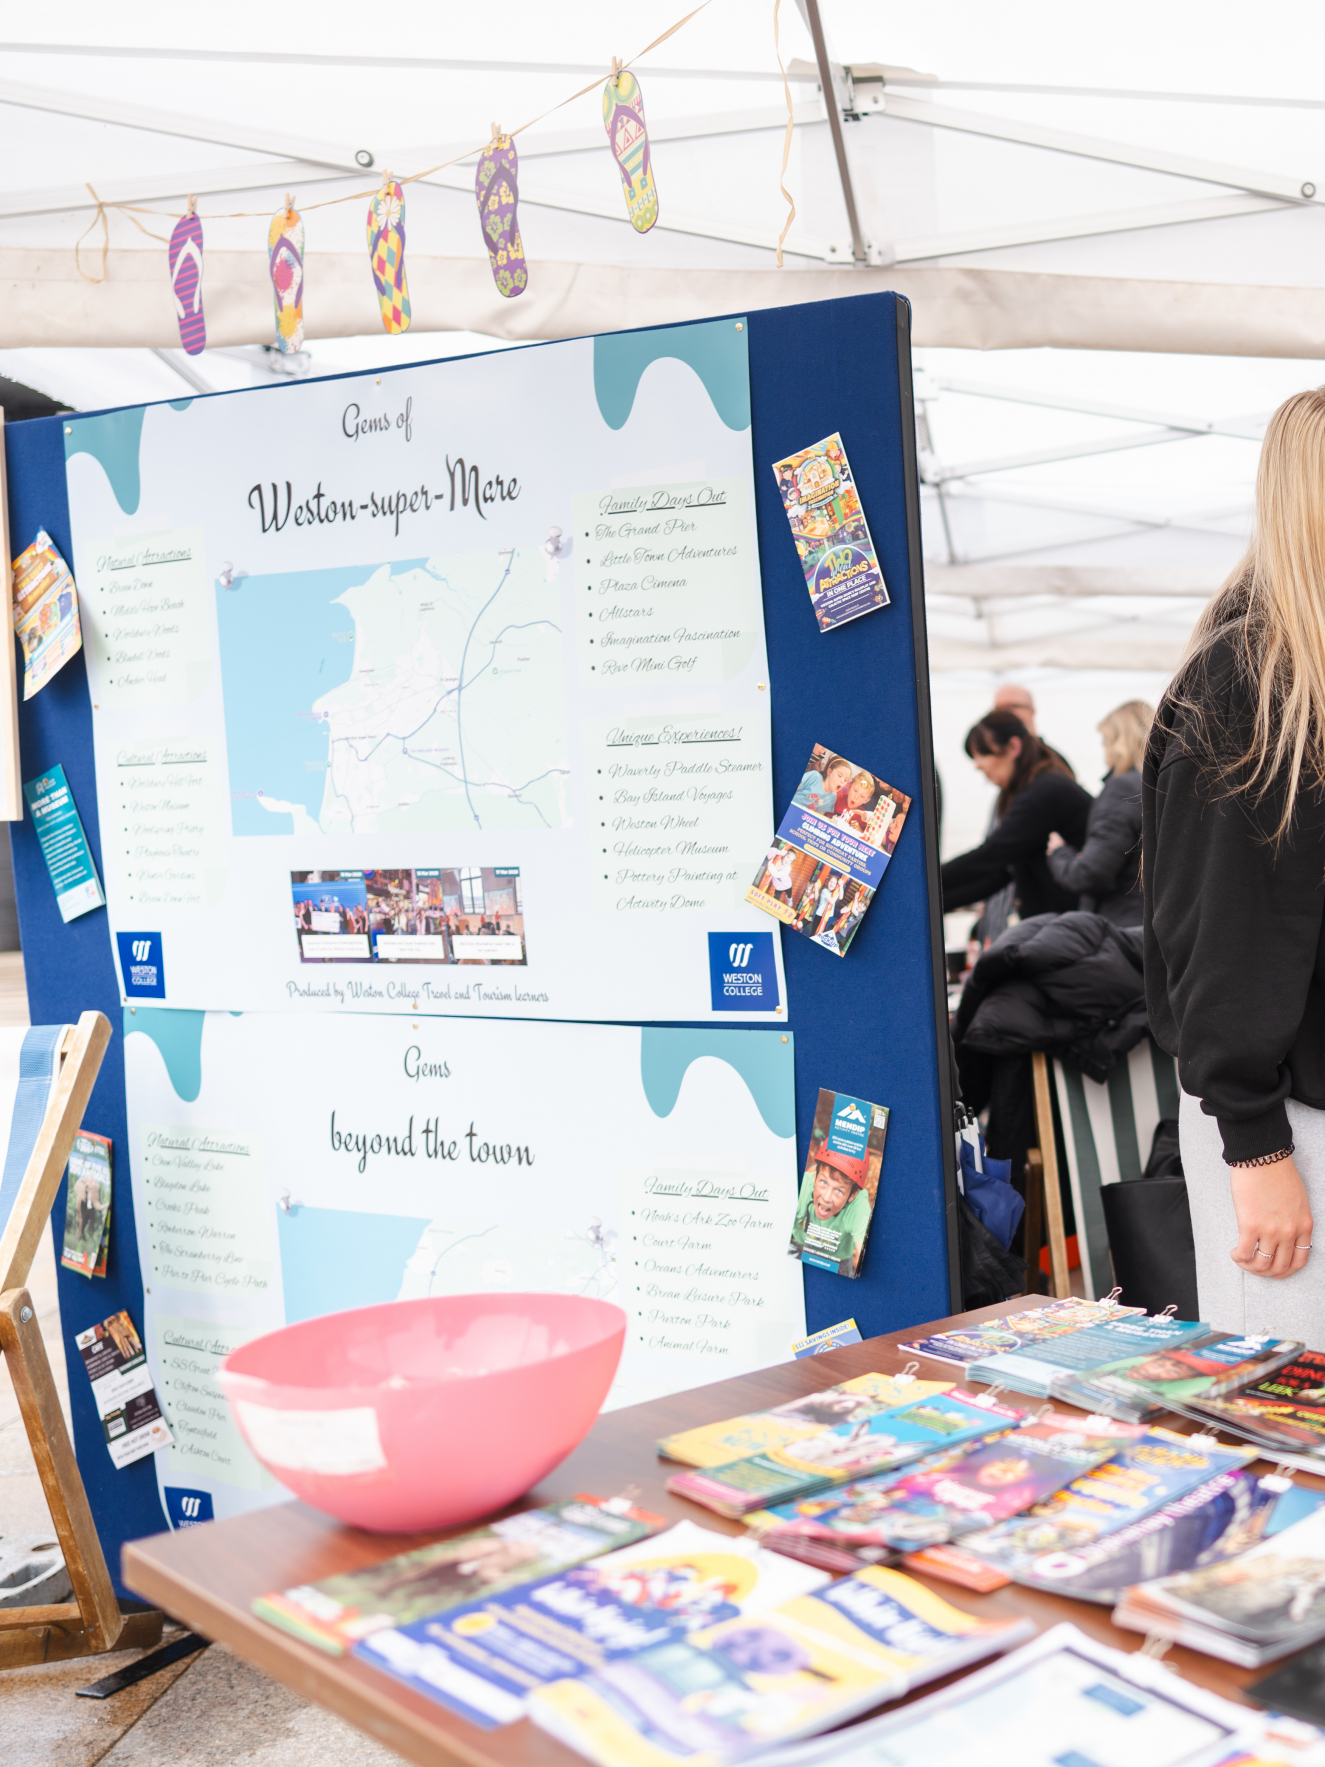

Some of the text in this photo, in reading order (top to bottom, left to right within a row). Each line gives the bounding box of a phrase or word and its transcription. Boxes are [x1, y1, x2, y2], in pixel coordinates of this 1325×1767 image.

[342, 396, 413, 442] Gems of
[248, 453, 522, 537] Weston-super-Mare
[599, 486, 728, 516] Family Days Out
[595, 518, 698, 541] The Grand Pier
[599, 545, 739, 568] Little Town Adventures
[598, 575, 688, 596] Plaza Cimena
[598, 605, 655, 623] Allstars
[600, 626, 741, 649] Imagination Fascination
[601, 655, 699, 676] Revo Mini Golf
[605, 724, 743, 748] Unique Experiences!
[608, 758, 764, 779] Waverly Paddle Steamer
[612, 785, 734, 806] Bay Island Voyages
[611, 814, 700, 832] Weston Wheel
[612, 840, 730, 859] Helicopter Museum
[615, 867, 739, 886] Pottery Painting at
[615, 894, 706, 912] Activity Dome
[722, 973, 762, 984] WESTON
[285, 980, 549, 1004] Produced by Weston College Travel and Tourism learners
[723, 986, 763, 996] COLLEGE
[403, 1045, 453, 1084] Gems
[834, 1118, 866, 1133] MENDIP
[147, 1131, 190, 1149] Natural
[330, 1109, 536, 1174] beyond the town
[644, 1176, 770, 1200] Family Days Out
[640, 1208, 775, 1230] Noah's Ark Zoo Farm
[642, 1233, 713, 1251] Court Farm
[643, 1258, 760, 1281] Oceans Adventurers
[646, 1283, 764, 1308] Brean Leisure Park
[648, 1309, 732, 1330] Puxton Park
[163, 1329, 204, 1352] Cultural
[648, 1336, 730, 1355] Animal Farm
[804, 1330, 831, 1346] SAVINGS
